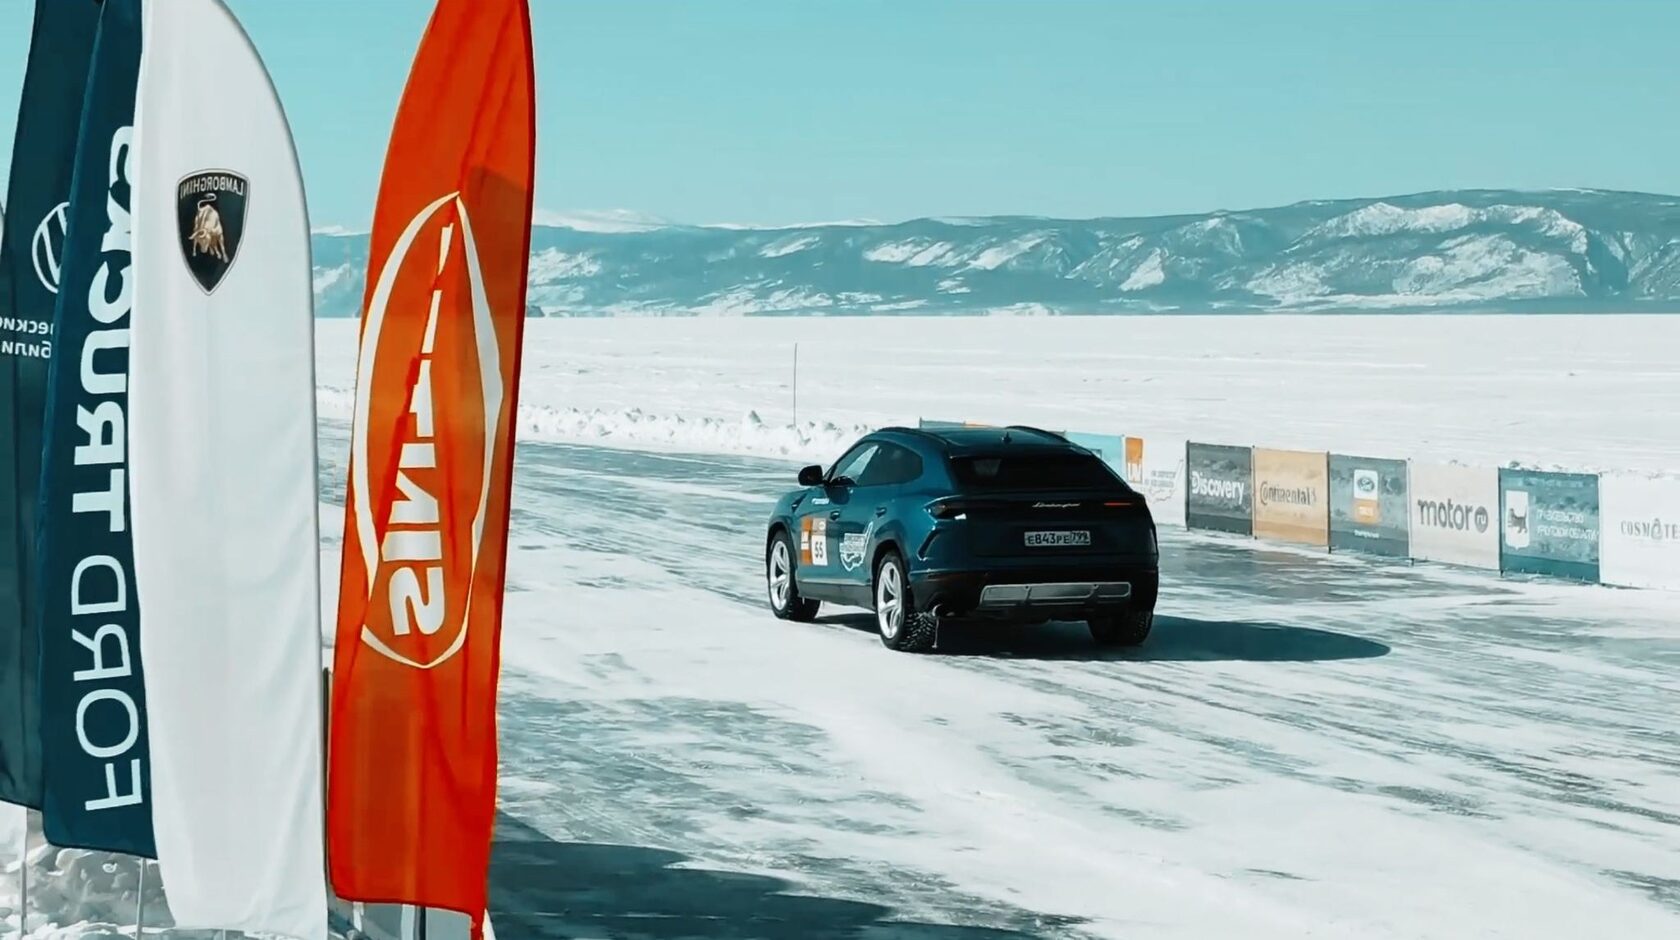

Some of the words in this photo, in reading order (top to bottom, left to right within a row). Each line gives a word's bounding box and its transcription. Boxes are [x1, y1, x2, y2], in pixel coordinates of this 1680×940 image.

[1192, 471, 1244, 505] Discovery
[1260, 481, 1312, 506] Continental
[1418, 498, 1473, 531] motor
[814, 541, 824, 559] 55
